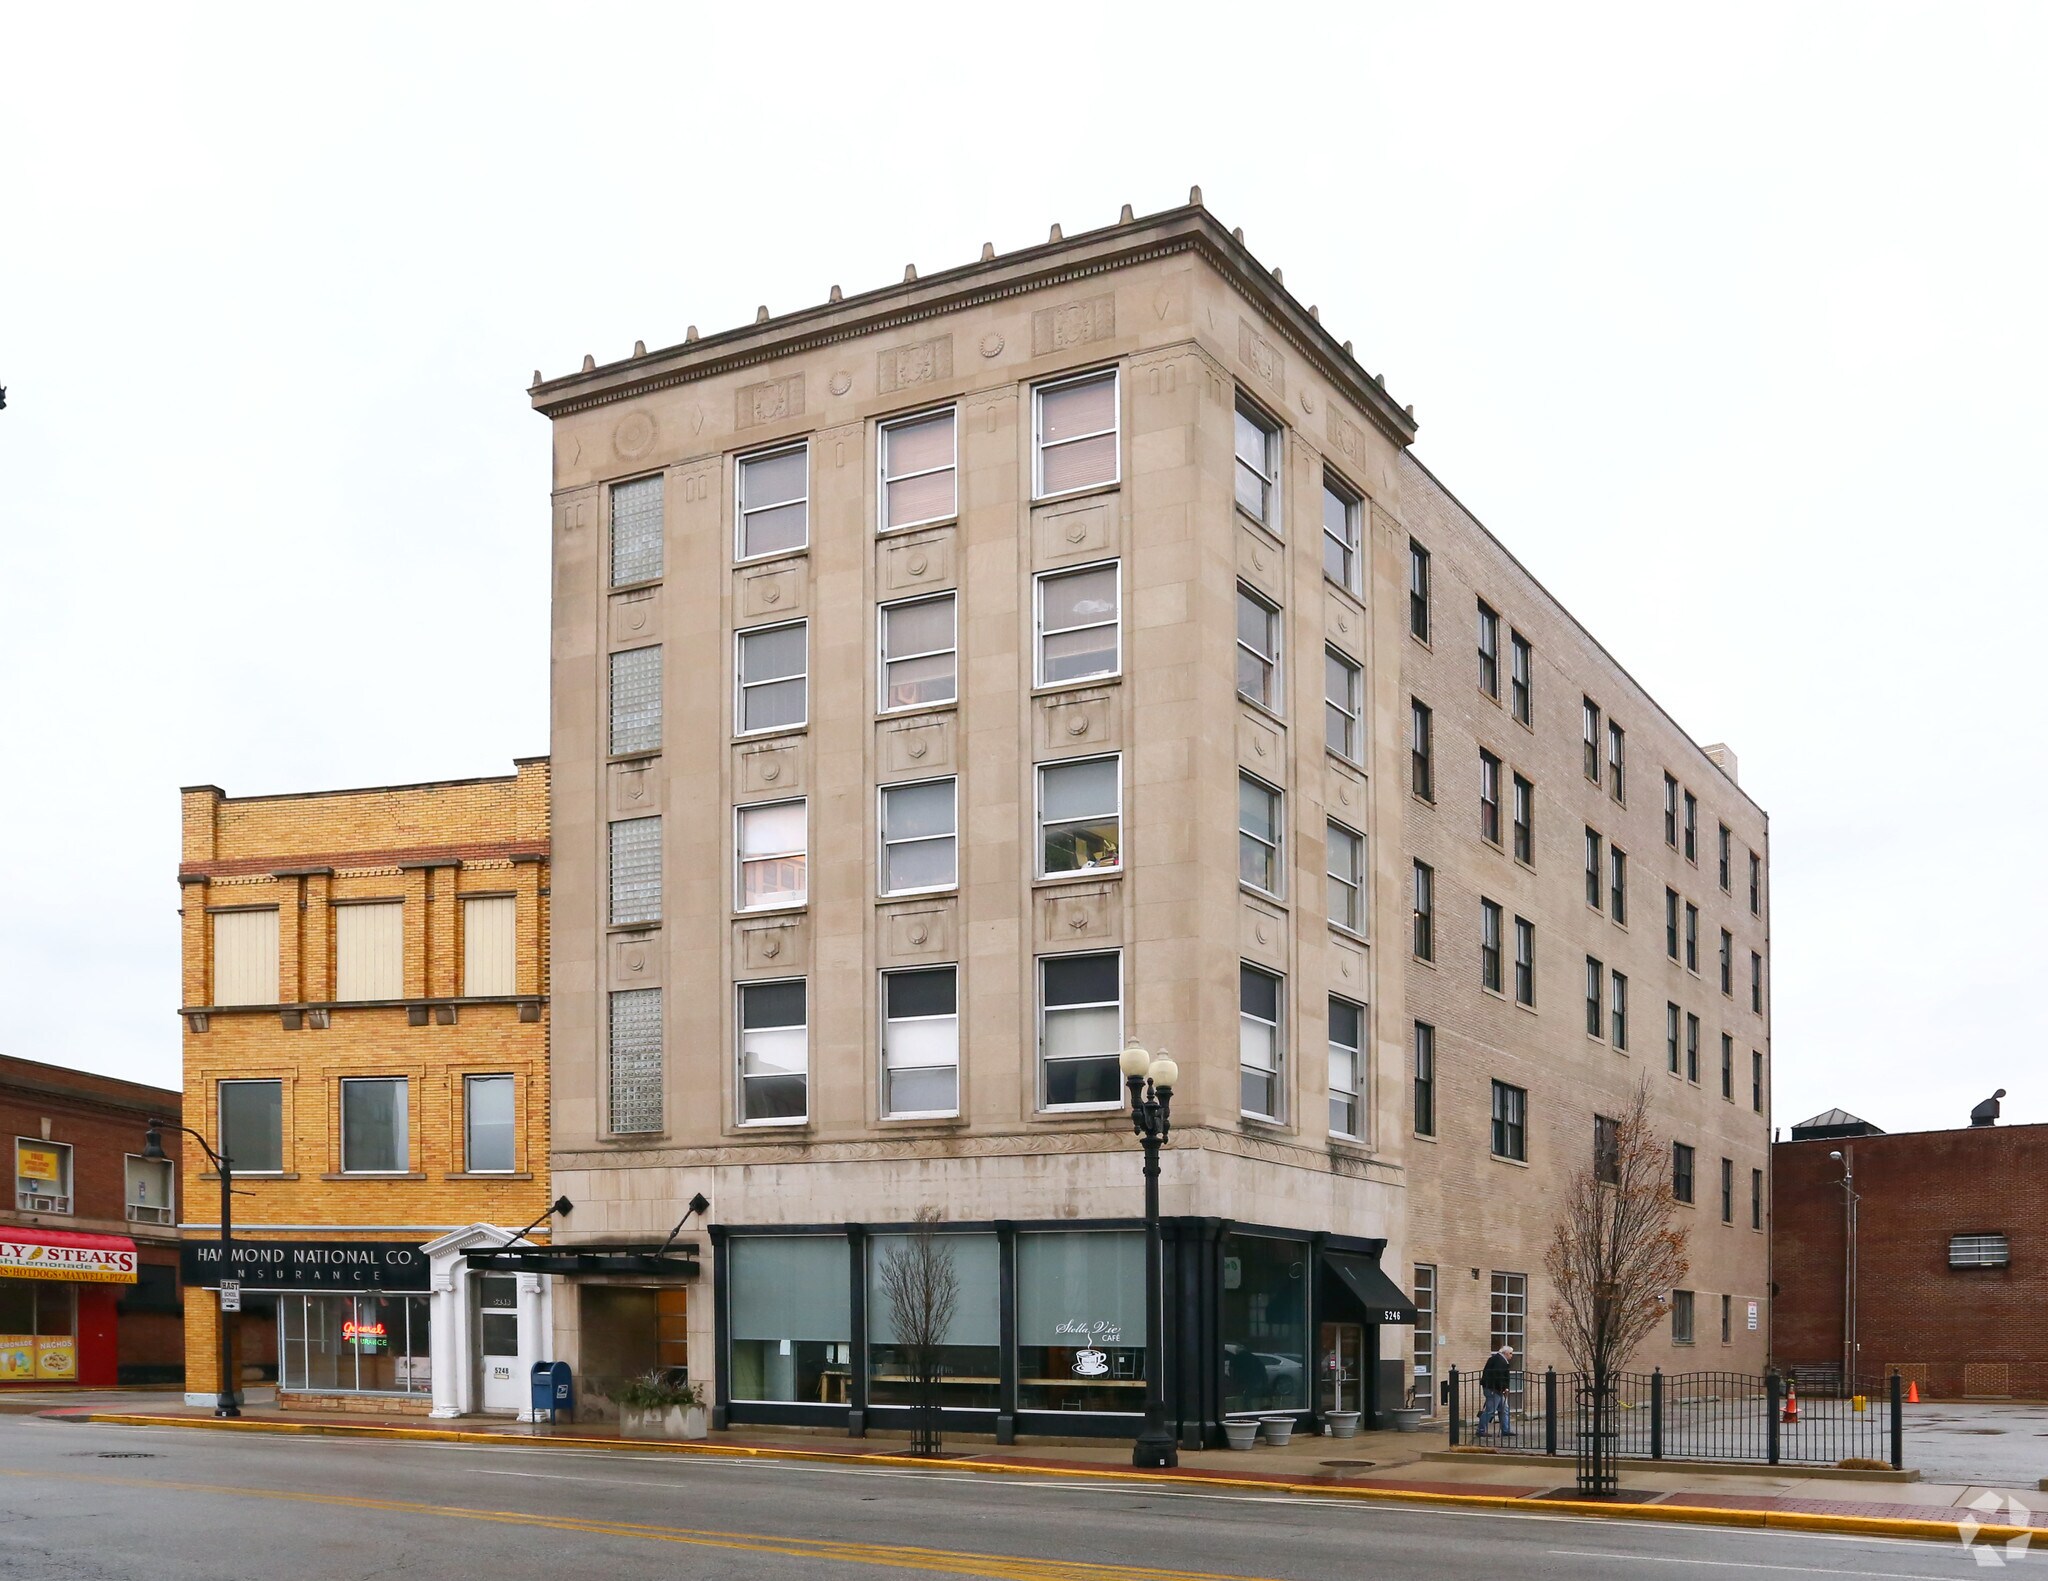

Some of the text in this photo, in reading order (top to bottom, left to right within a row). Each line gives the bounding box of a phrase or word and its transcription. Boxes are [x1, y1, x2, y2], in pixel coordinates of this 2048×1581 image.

[47, 1248, 133, 1272] STEAKS
[197, 1248, 418, 1265] HAMOND NATIONAL CO.
[17, 1258, 92, 1270] Lemonade
[109, 1273, 133, 1283] PIZZA
[237, 1269, 380, 1280] NSURANCE
[1384, 1310, 1401, 1320] 5246
[1055, 1319, 1121, 1335] Stella Vie
[1101, 1333, 1120, 1342] CAFÉ
[40, 1340, 72, 1350] NACHOS
